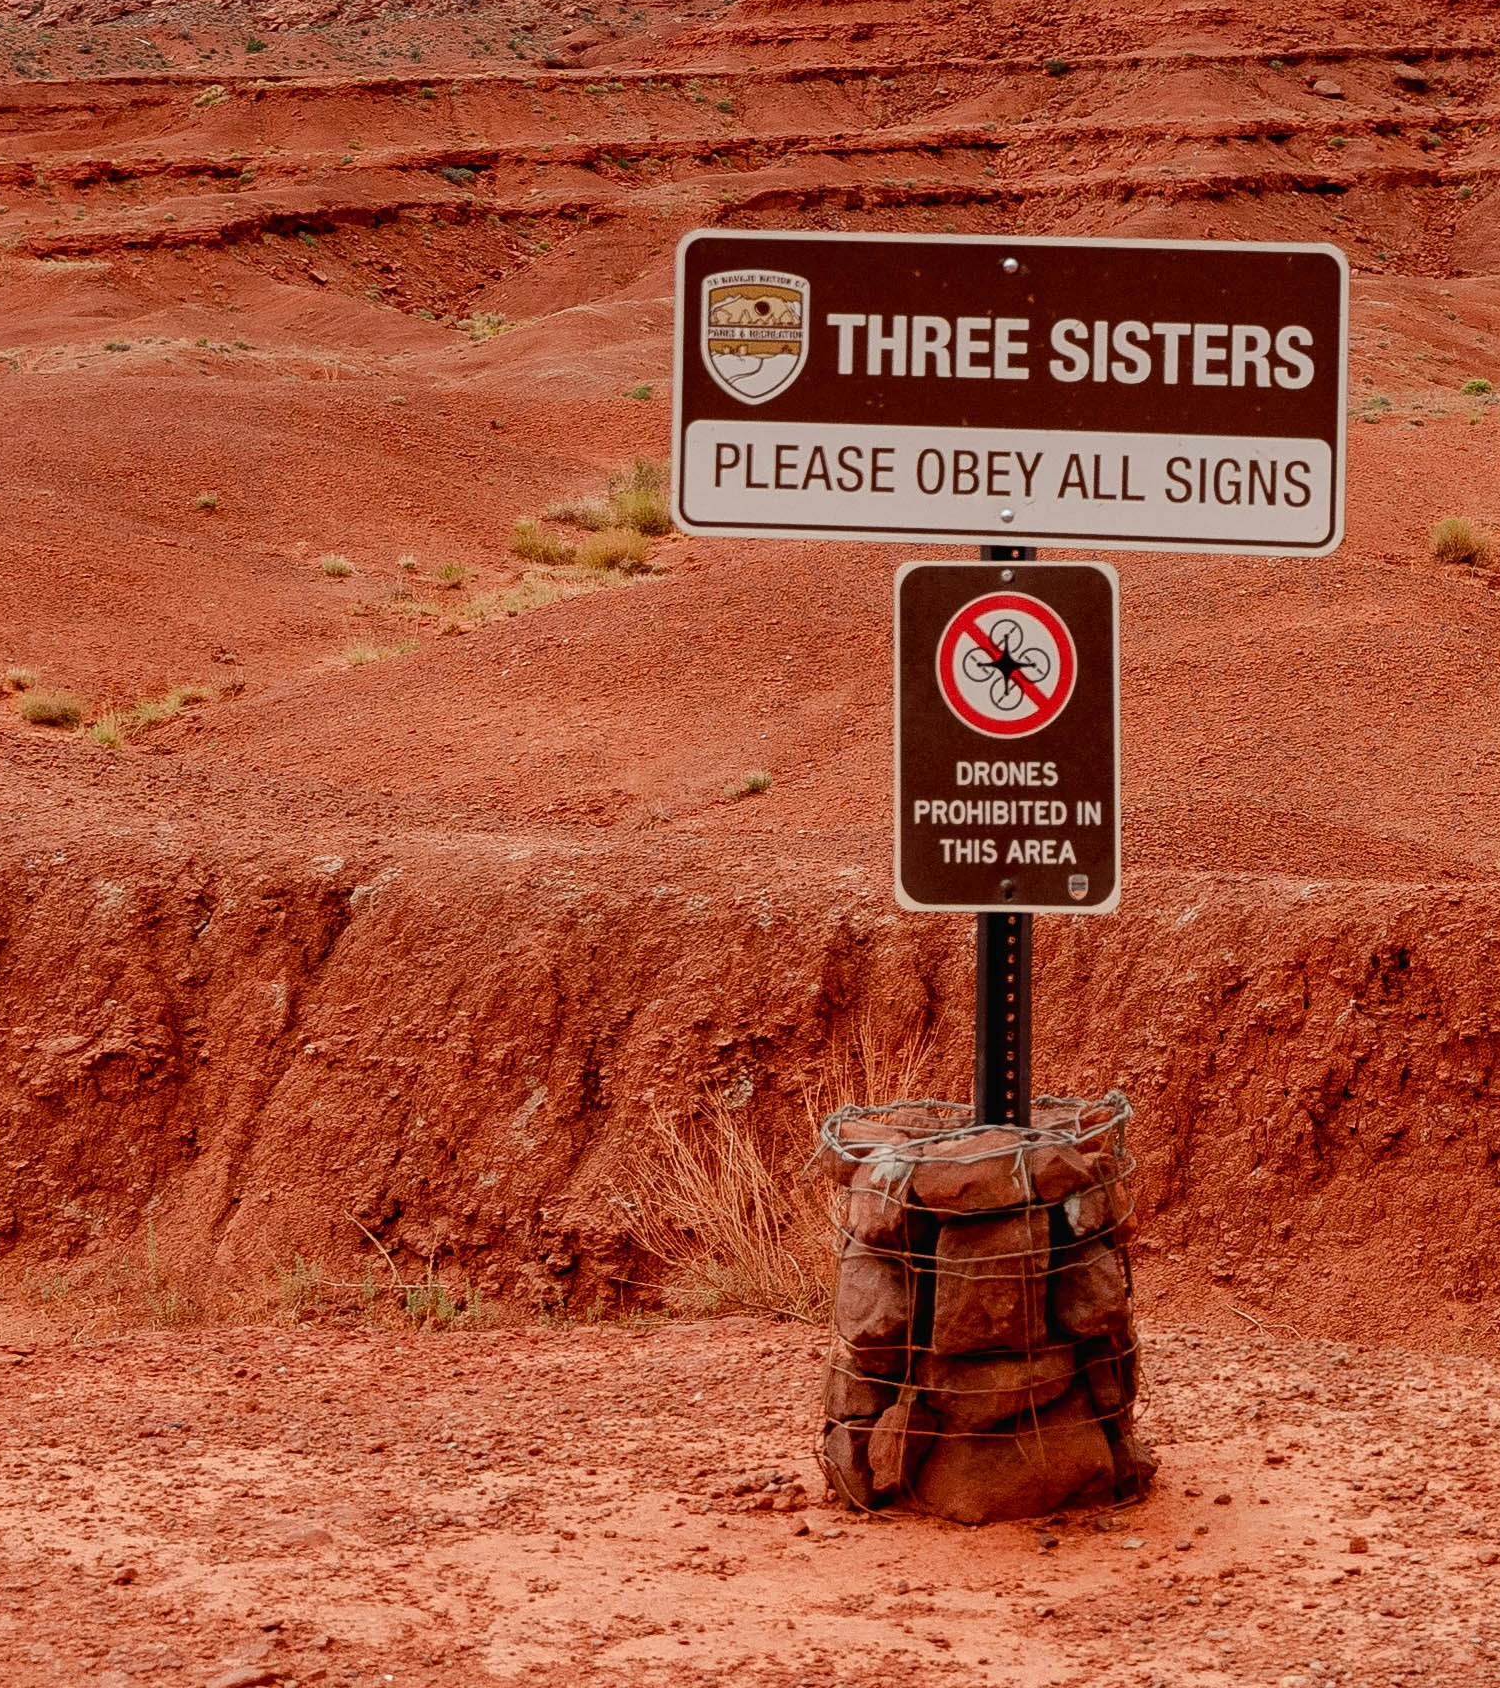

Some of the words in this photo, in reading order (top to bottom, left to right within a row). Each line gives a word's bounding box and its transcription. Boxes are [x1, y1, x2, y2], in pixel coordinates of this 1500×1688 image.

[826, 313, 1030, 380] THREE
[1049, 318, 1315, 390] SISTERS
[714, 442, 896, 493] PLEASE
[916, 448, 1044, 498] OBEY
[1057, 453, 1146, 502] ALL
[1164, 456, 1312, 508] SIGNS
[956, 761, 1059, 787] DRONES
[914, 799, 1068, 826] PROHIBITED
[1076, 800, 1102, 826] IN
[939, 838, 998, 864] THIS
[1006, 839, 1077, 865] AREA
